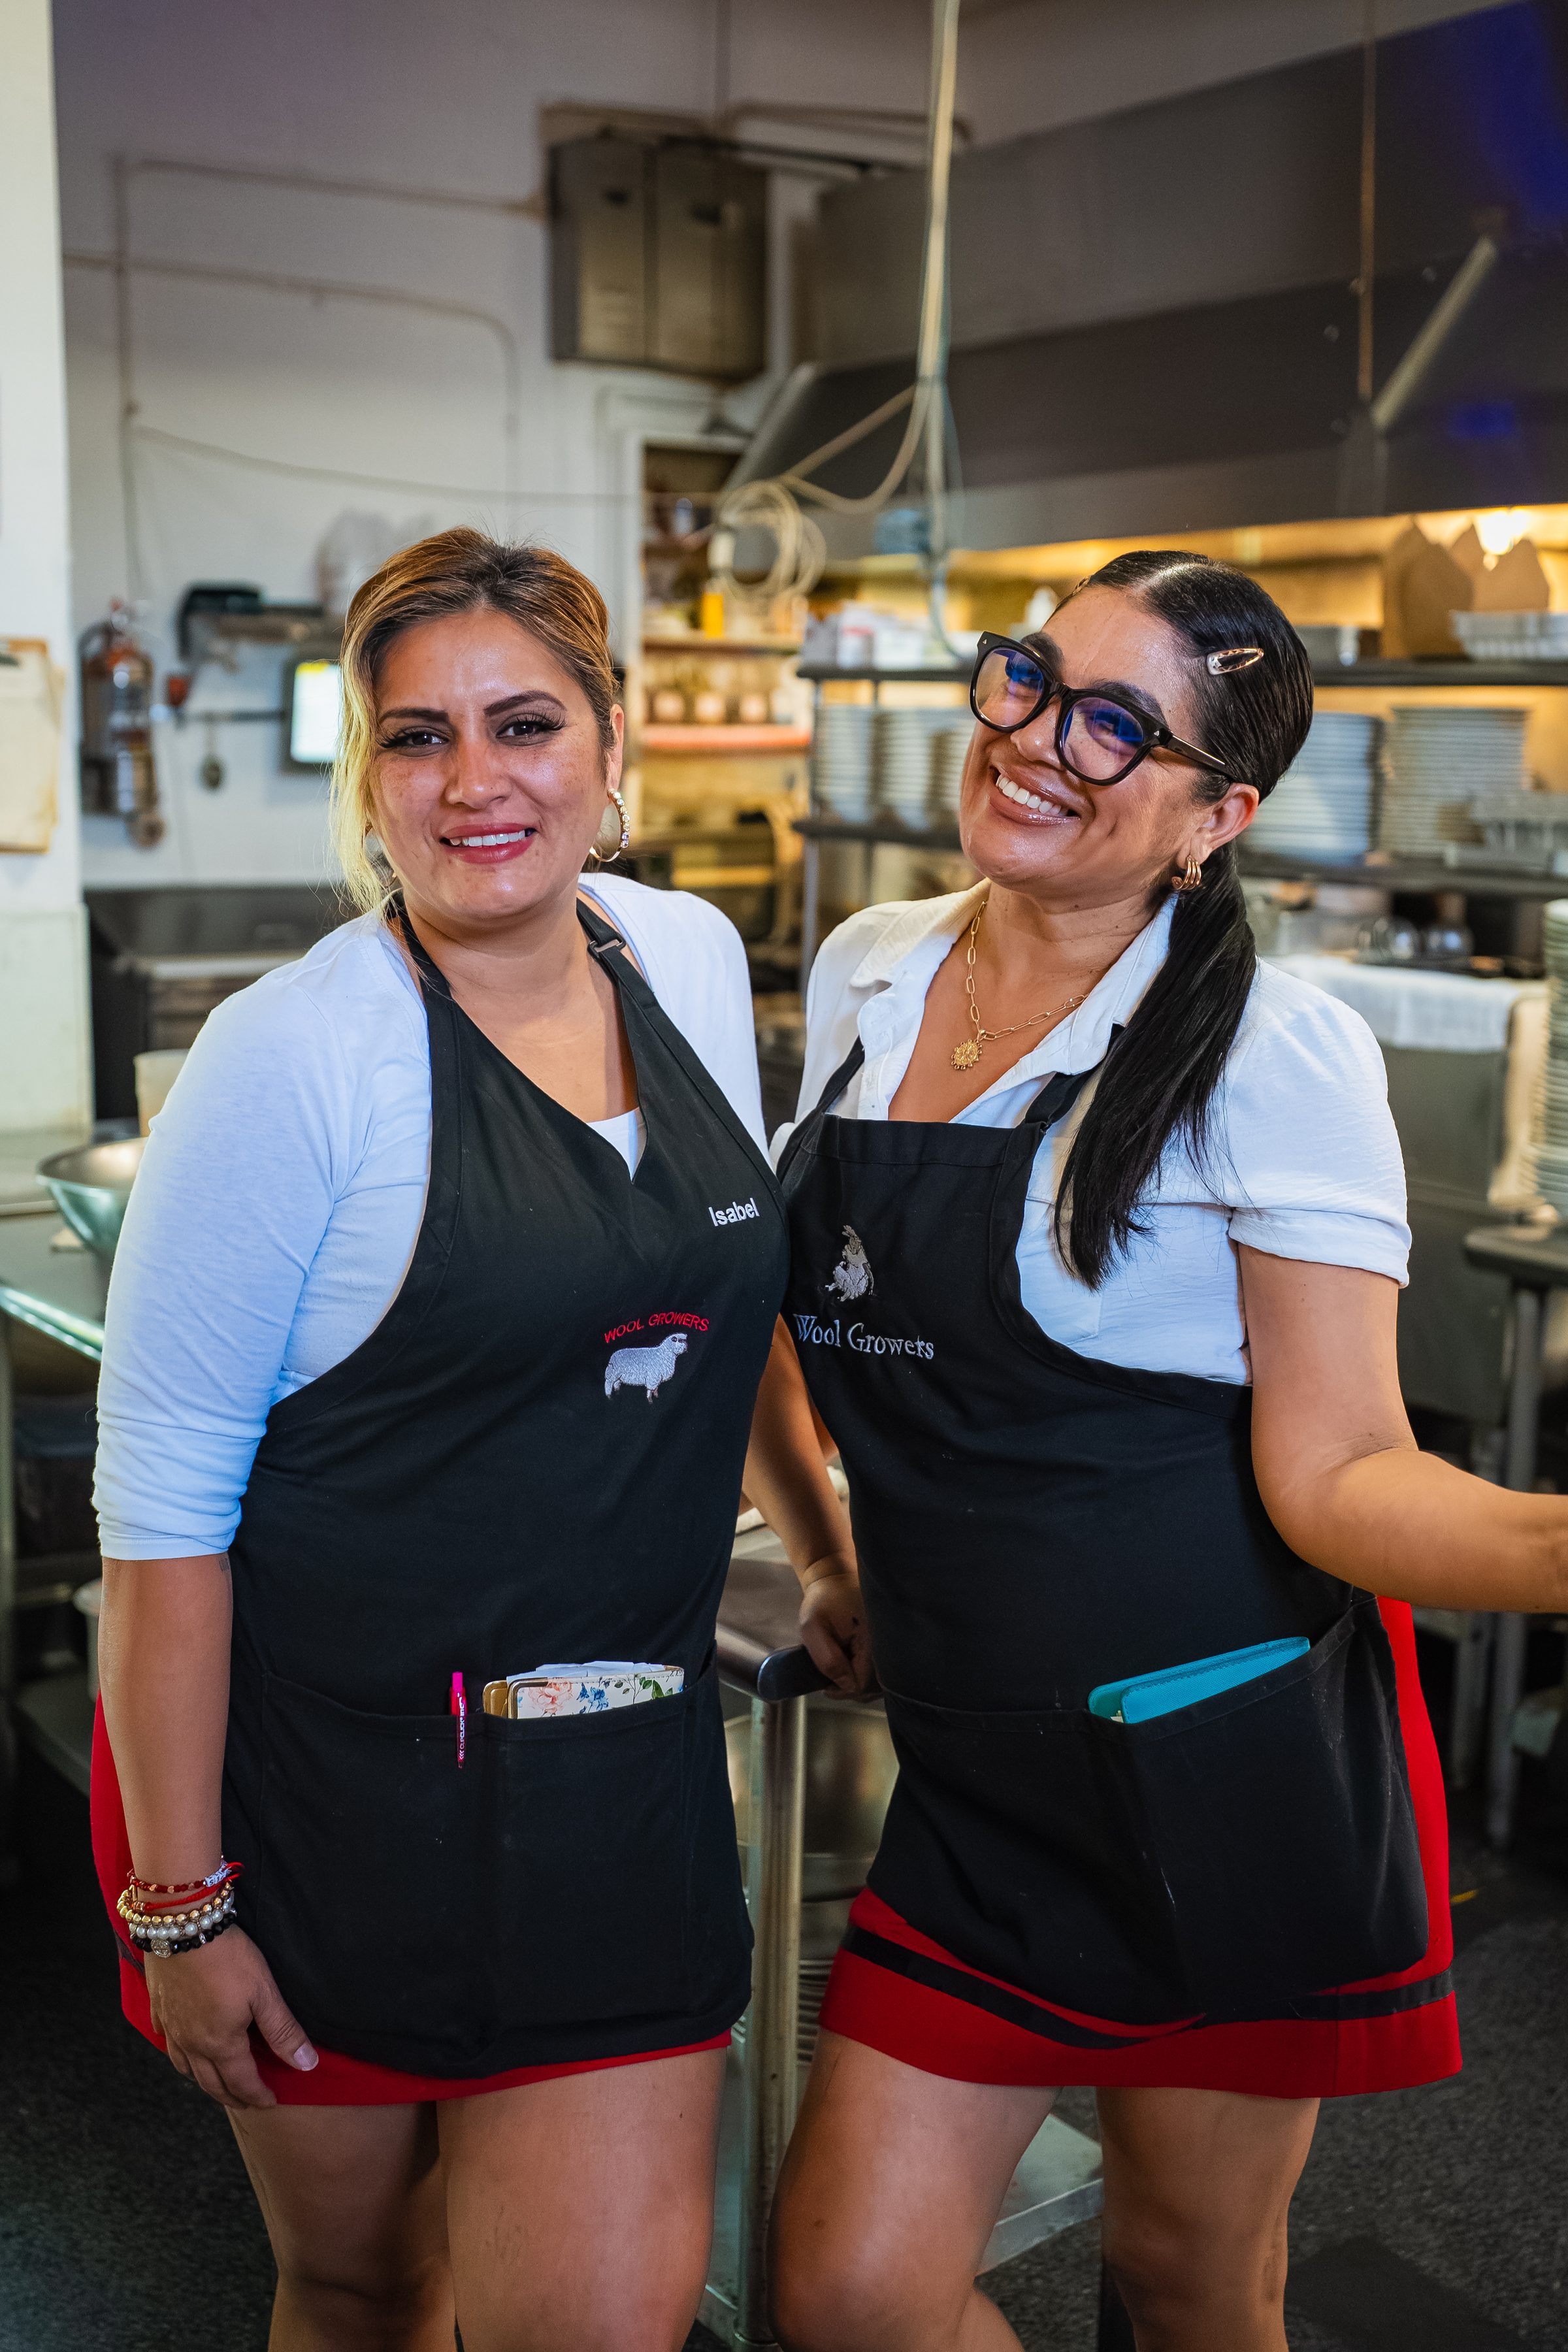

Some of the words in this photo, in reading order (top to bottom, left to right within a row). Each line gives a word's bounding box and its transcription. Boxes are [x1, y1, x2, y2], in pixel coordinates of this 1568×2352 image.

[708, 1197, 760, 1227] Isabel
[604, 1318, 645, 1343] WOOL
[648, 1311, 710, 1331] GROWERS
[792, 1313, 841, 1348] Wool
[847, 1322, 934, 1360] Growers
